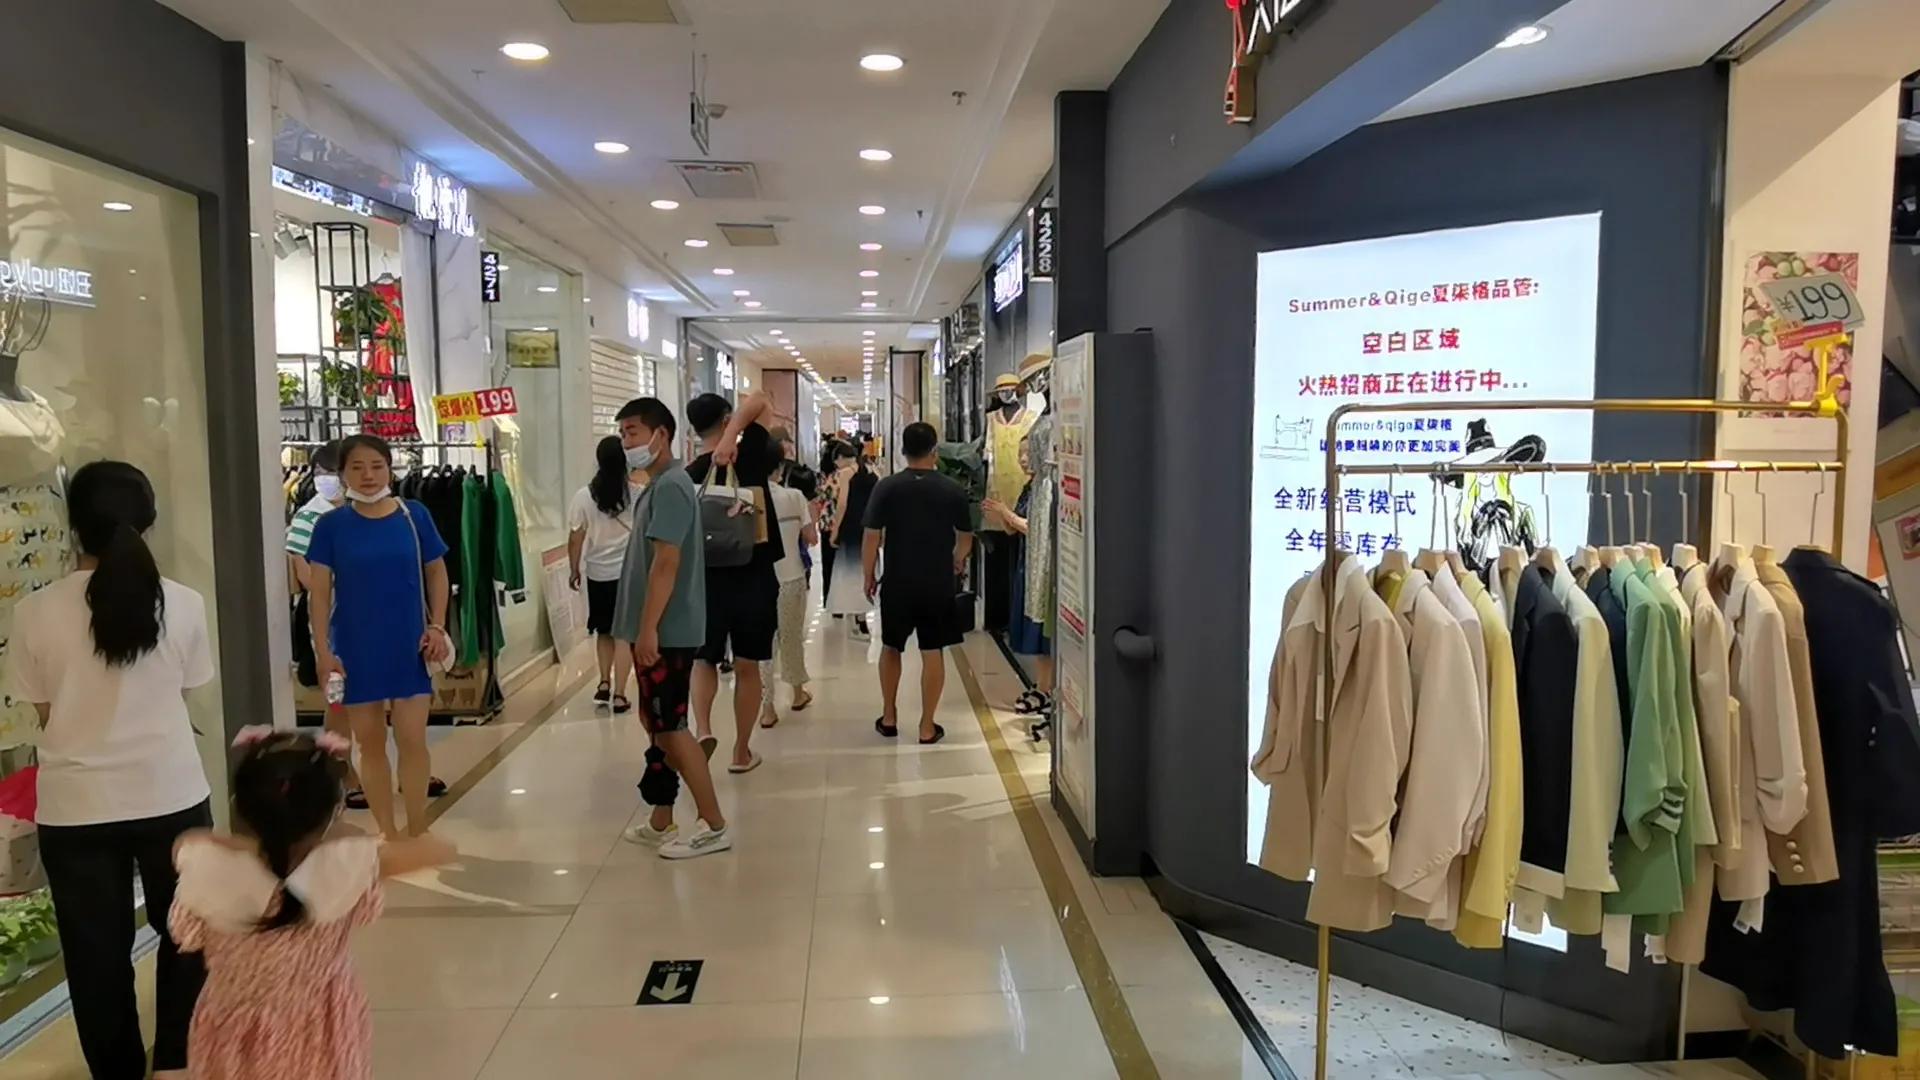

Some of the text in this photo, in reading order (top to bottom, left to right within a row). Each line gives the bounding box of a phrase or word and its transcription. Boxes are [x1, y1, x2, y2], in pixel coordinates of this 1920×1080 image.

[1038, 212, 1052, 273] 4228
[483, 253, 497, 300] 4271
[1362, 328, 1460, 354] 空白区域
[477, 389, 514, 414] 199
[1274, 486, 1417, 515] 全新经营模式
